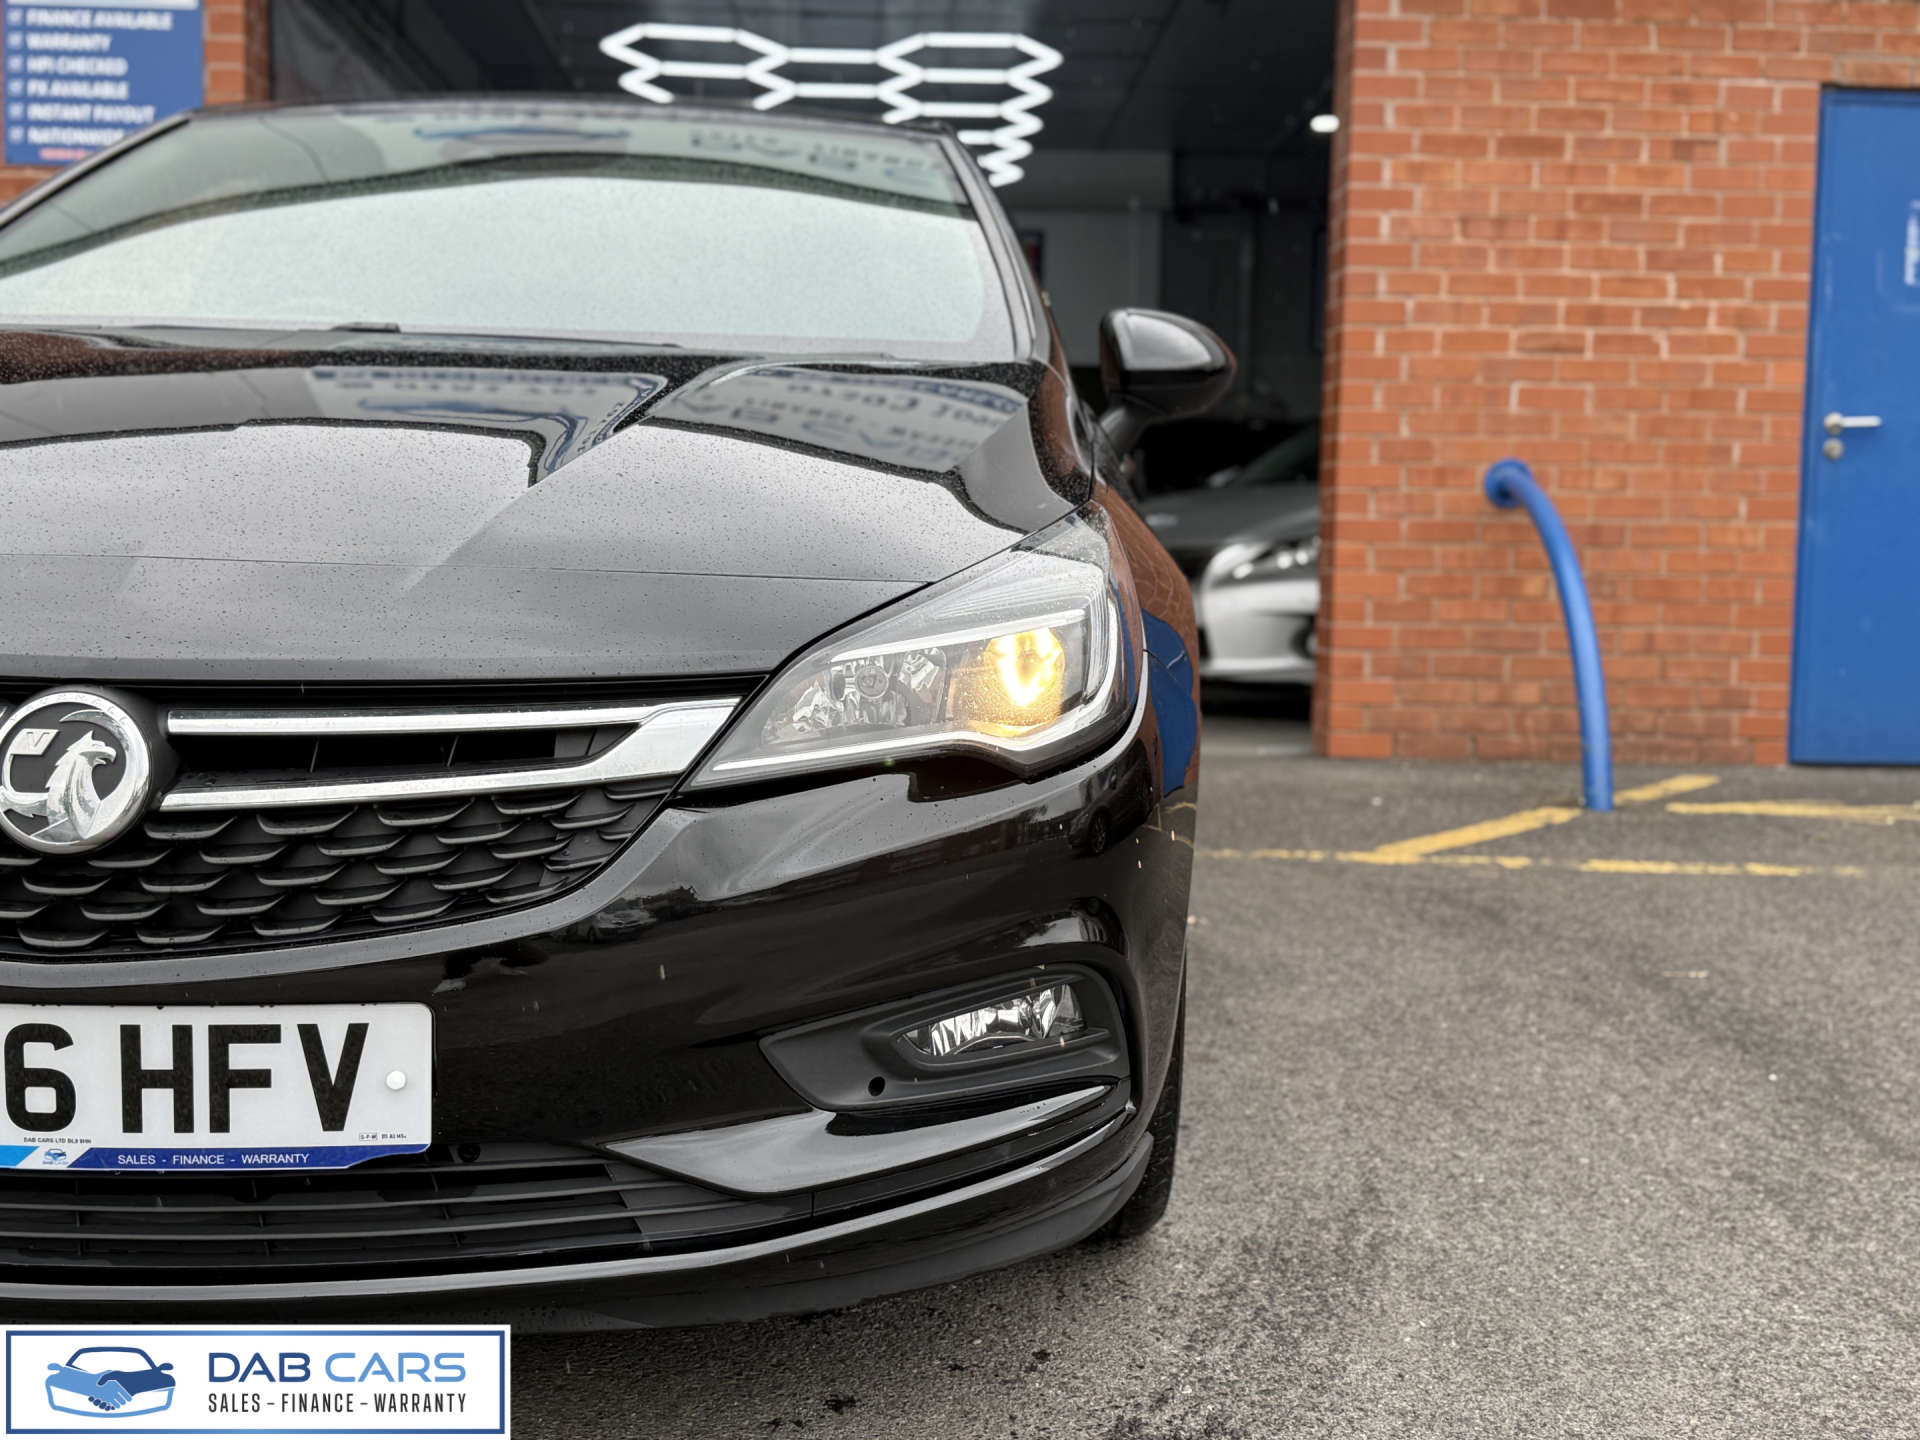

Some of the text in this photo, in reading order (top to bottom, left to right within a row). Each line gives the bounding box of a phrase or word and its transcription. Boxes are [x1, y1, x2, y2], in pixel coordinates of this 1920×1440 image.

[4, 1023, 369, 1133] 6 HFV
[118, 1155, 155, 1165] SALES
[173, 1155, 224, 1165] FINANCE
[242, 1154, 309, 1164] WARRANTY
